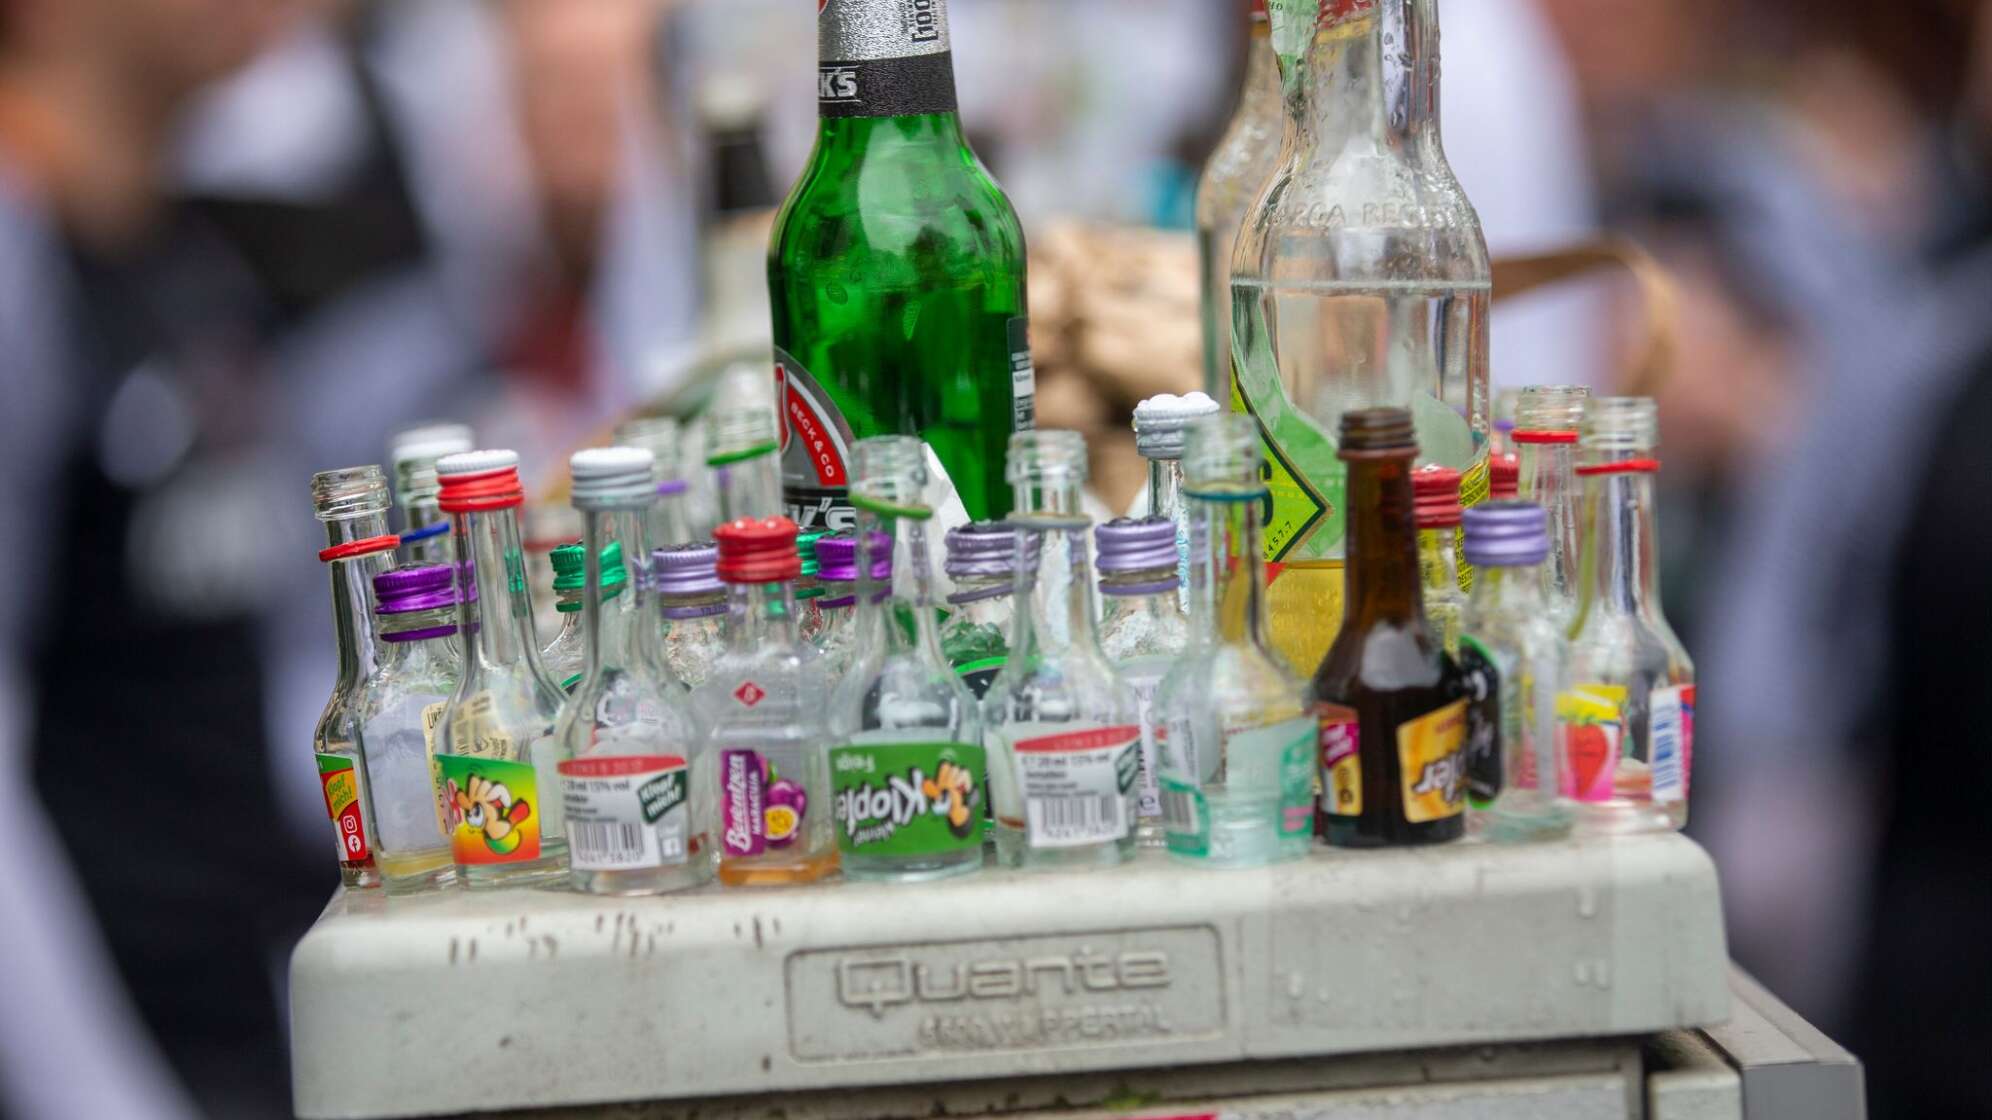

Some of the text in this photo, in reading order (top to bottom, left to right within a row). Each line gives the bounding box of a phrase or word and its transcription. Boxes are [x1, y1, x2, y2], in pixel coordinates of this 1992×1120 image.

[819, 67, 858, 98] K'S
[790, 402, 818, 443] BECK
[820, 454, 836, 478] CO
[836, 945, 1171, 1020] Quante
